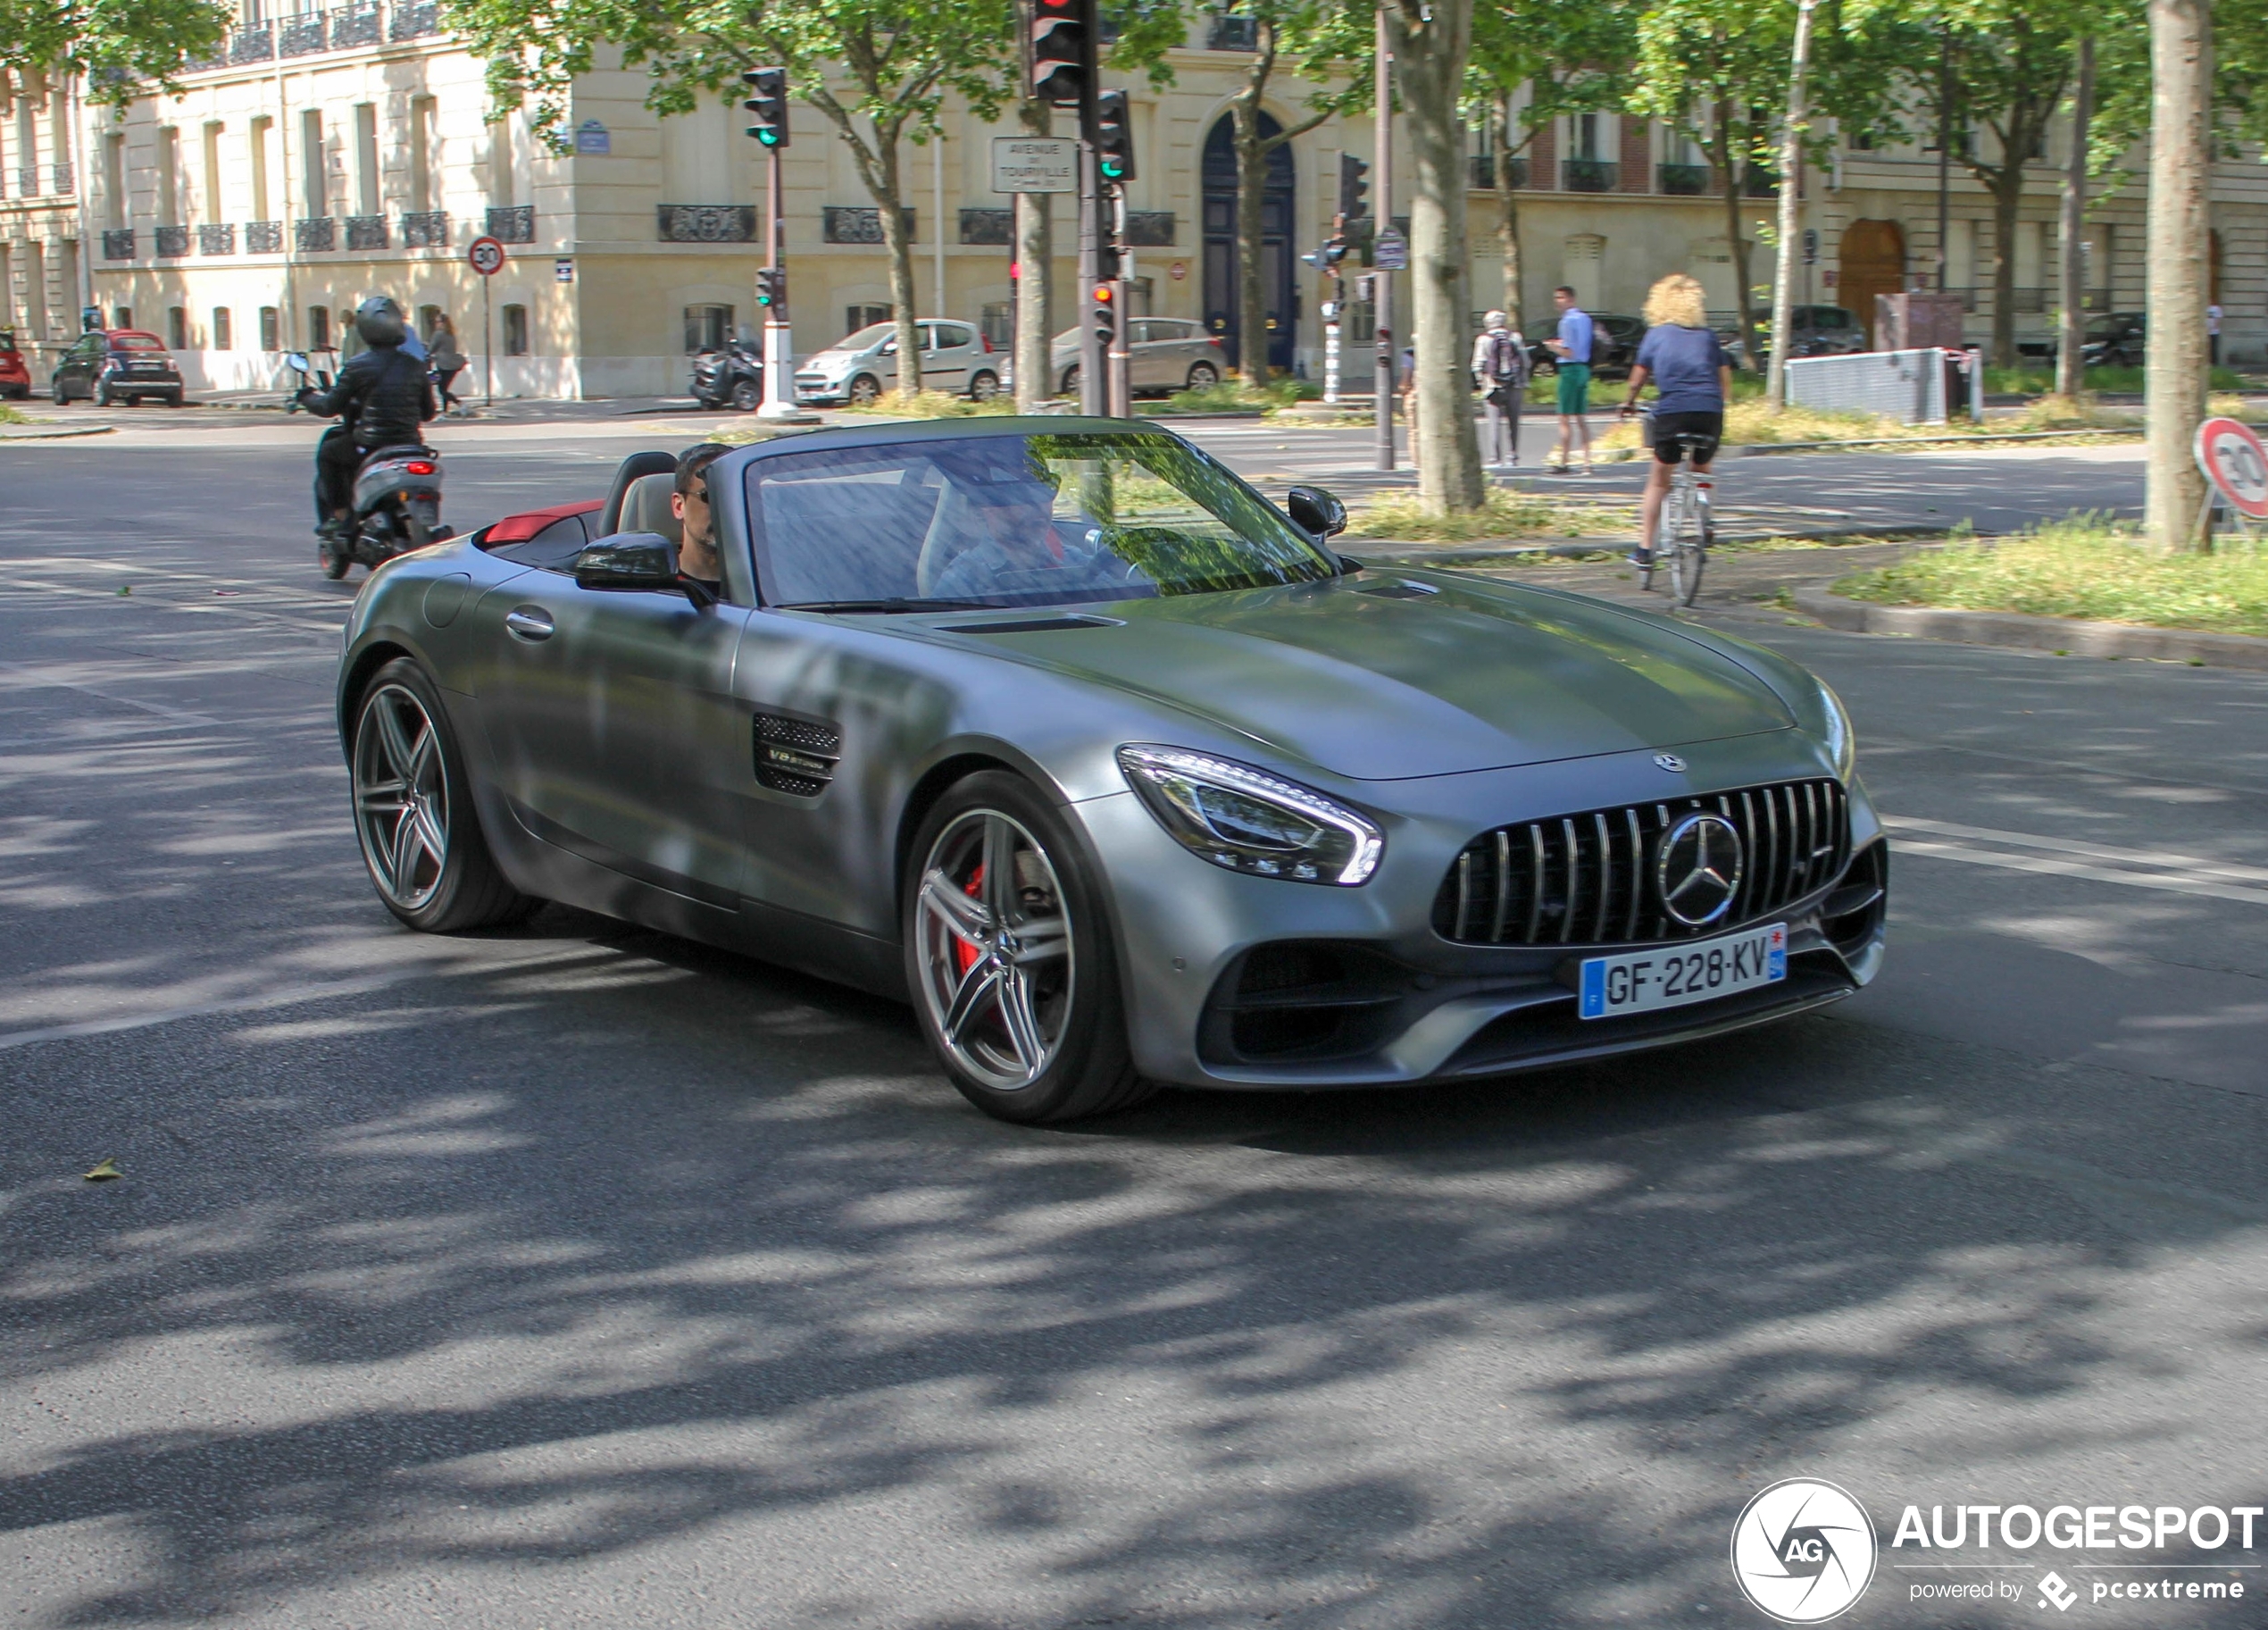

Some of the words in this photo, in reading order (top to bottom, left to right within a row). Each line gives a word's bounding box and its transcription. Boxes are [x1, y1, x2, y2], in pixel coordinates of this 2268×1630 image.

[1009, 144, 1060, 155] AVENUE
[999, 166, 1070, 178] TOURVILLE
[474, 247, 497, 265] 30
[2215, 445, 2266, 489] 30
[1608, 936, 1767, 1006] GF-228-KV
